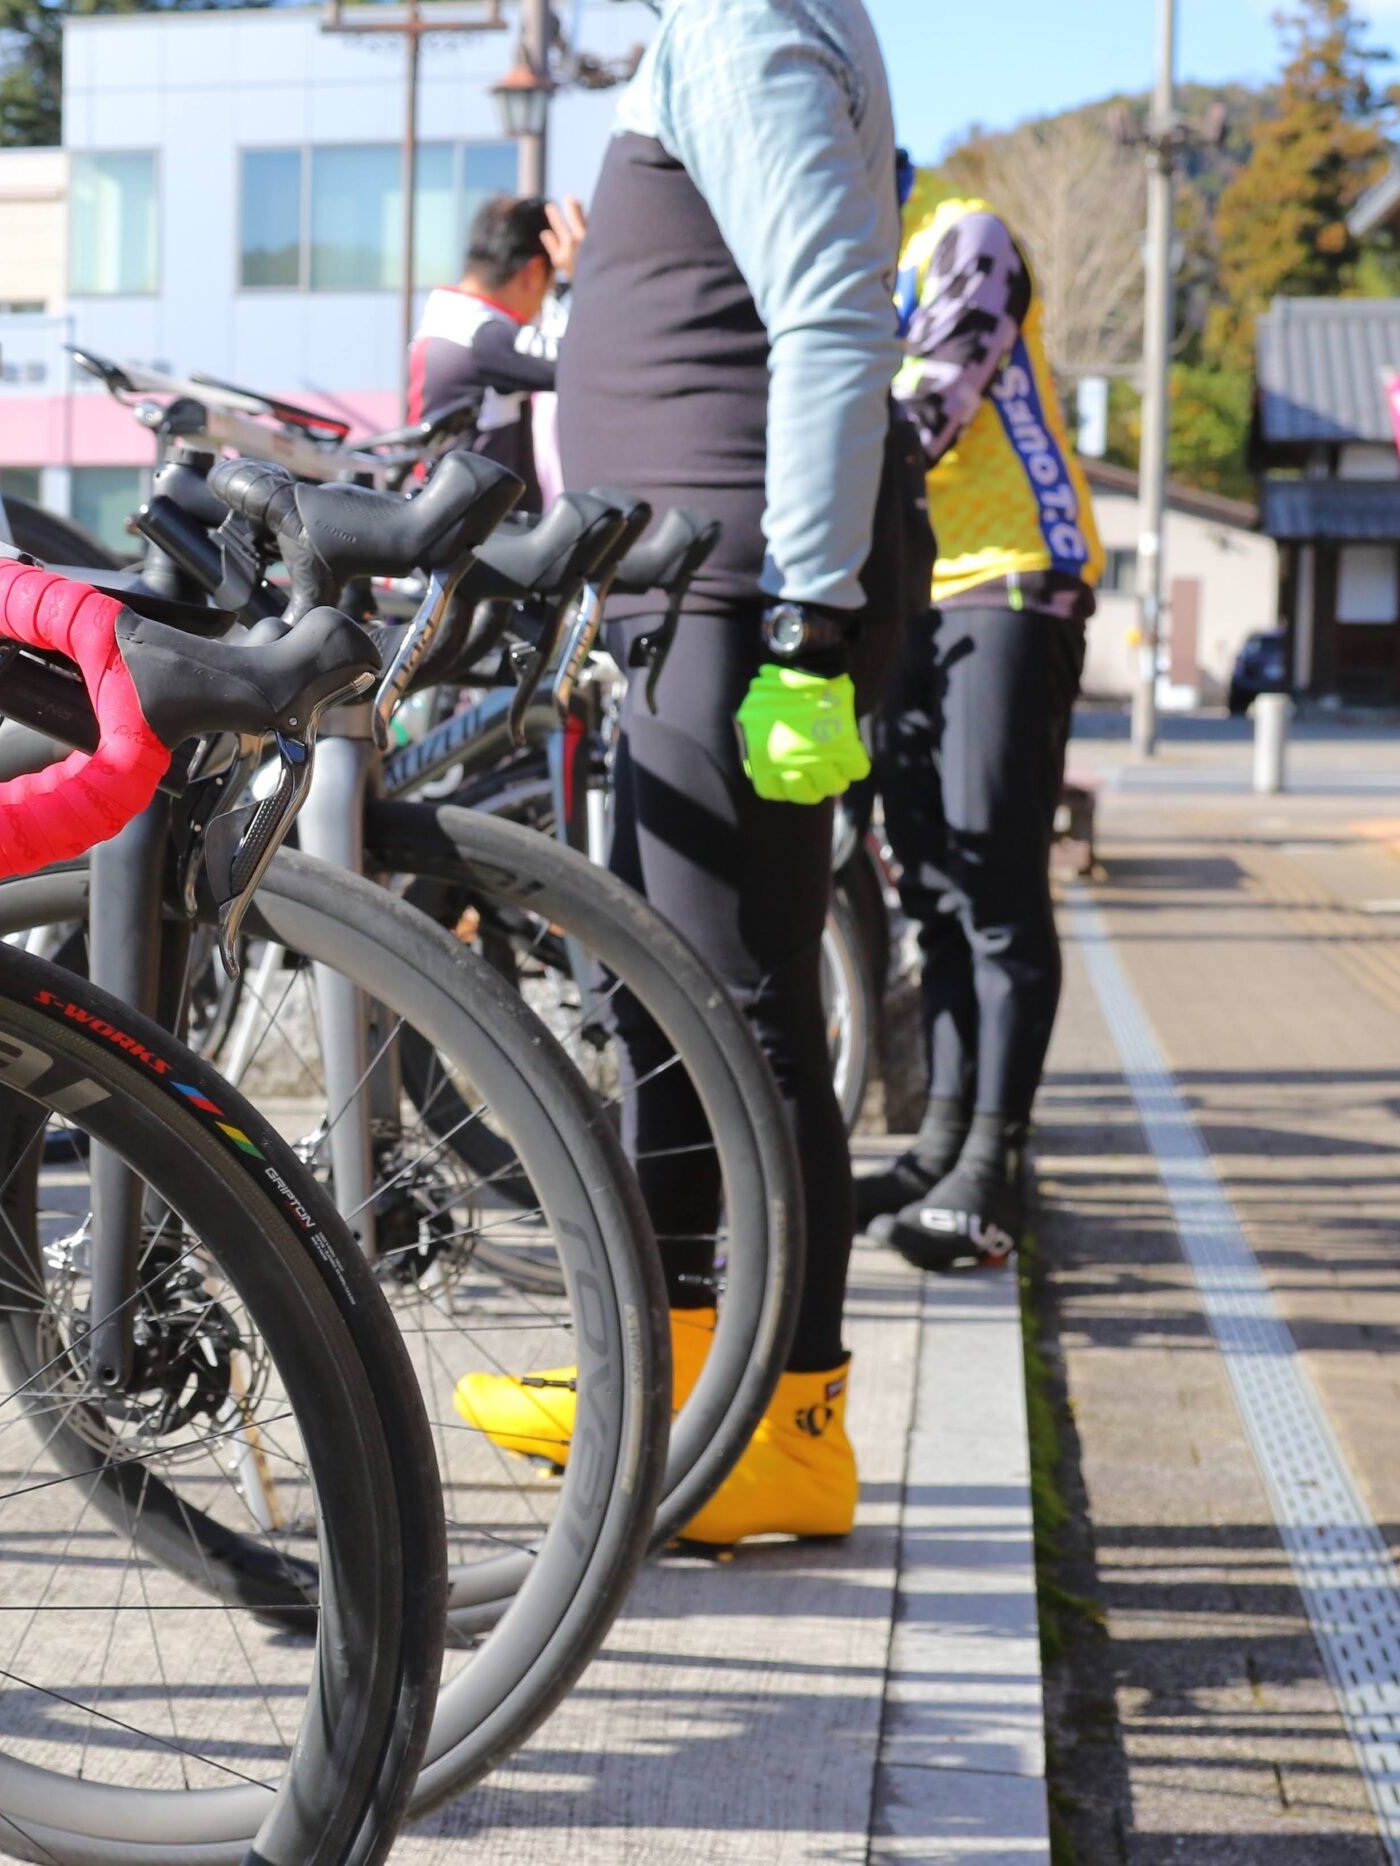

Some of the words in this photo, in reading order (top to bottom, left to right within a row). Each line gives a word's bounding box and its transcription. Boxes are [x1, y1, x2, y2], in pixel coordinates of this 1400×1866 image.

[33, 991, 173, 1075] S-WORKS
[264, 1167, 317, 1229] GRIPTON
[558, 1217, 612, 1557] roval
